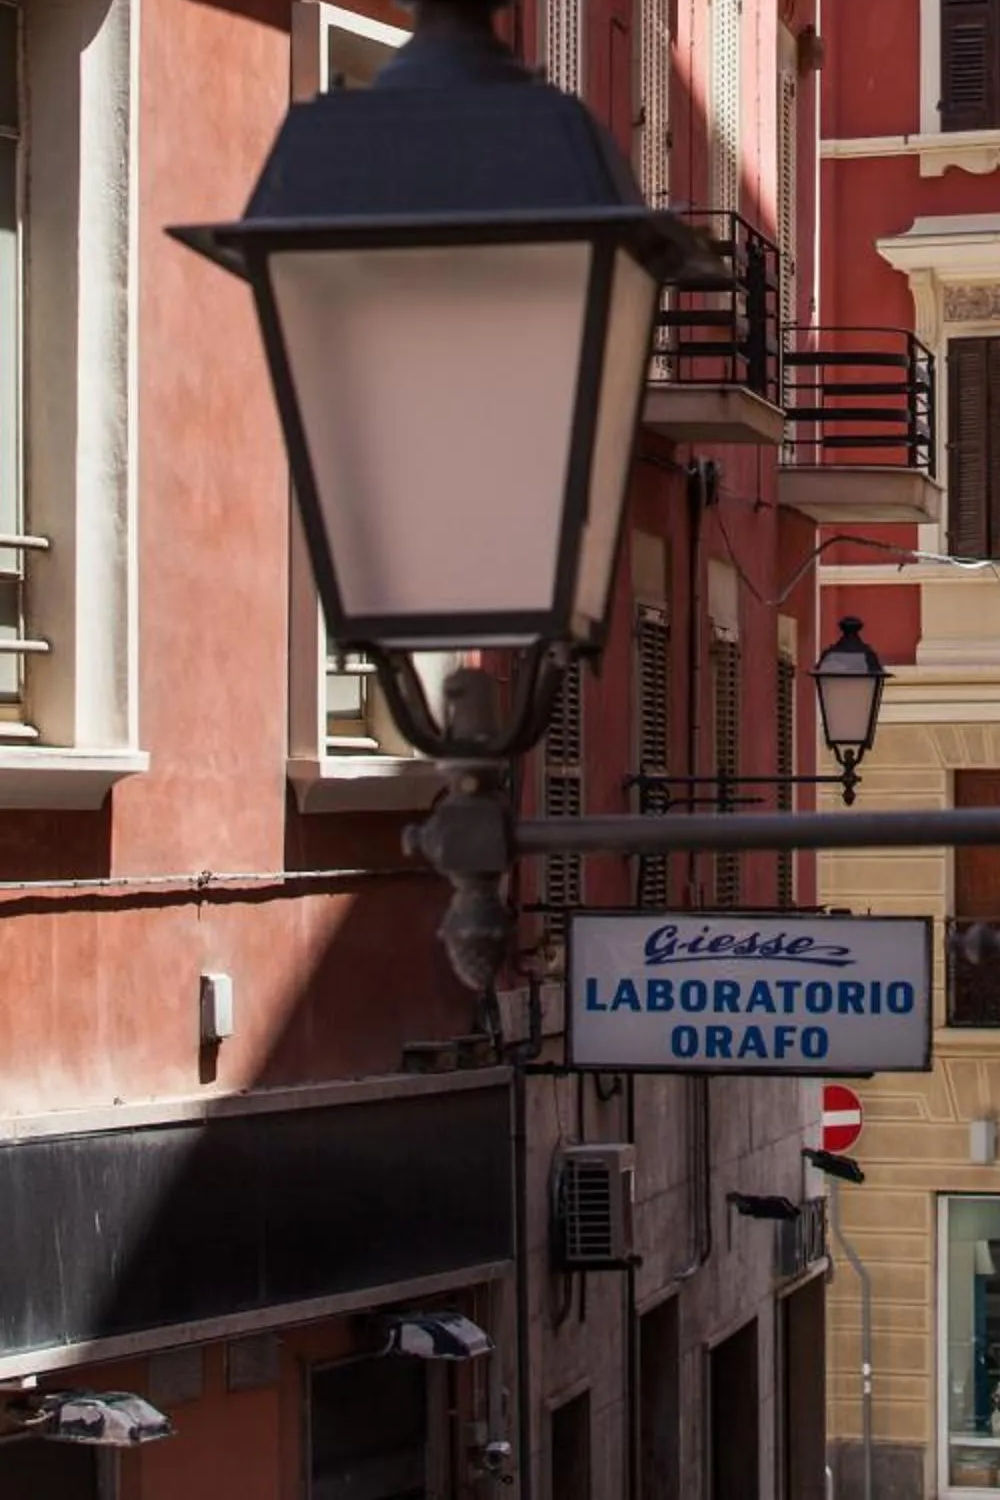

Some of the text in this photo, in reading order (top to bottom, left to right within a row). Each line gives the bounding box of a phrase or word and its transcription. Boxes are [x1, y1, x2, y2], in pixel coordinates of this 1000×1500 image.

[644, 924, 855, 966] Giesse
[585, 977, 915, 1014] LABORATORIO
[671, 1024, 829, 1059] ORAFO
